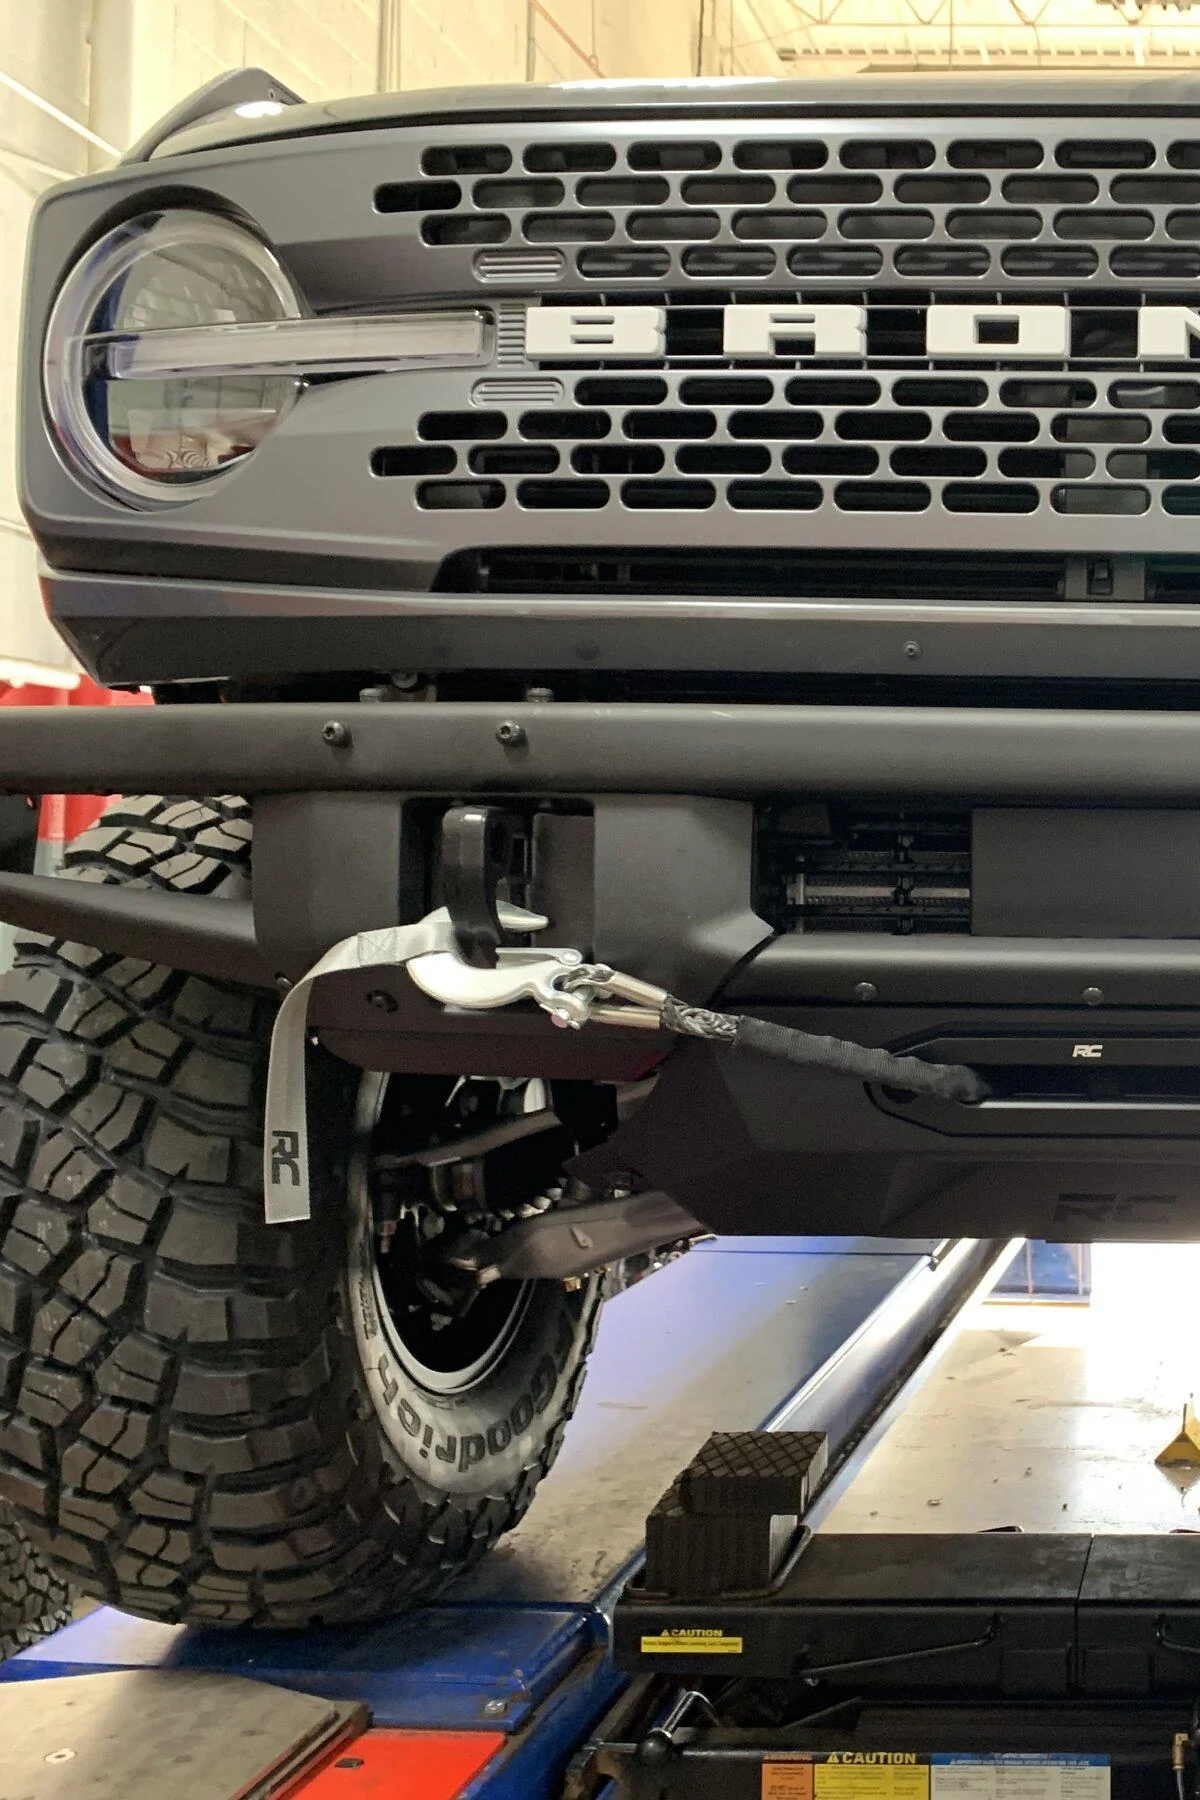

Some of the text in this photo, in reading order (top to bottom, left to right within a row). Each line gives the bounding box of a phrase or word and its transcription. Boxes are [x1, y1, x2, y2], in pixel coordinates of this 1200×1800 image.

[1072, 1044, 1103, 1058] RC
[271, 1130, 301, 1187] RC
[670, 1629, 723, 1637] CAUTION
[842, 1752, 916, 1765] CAUTION
